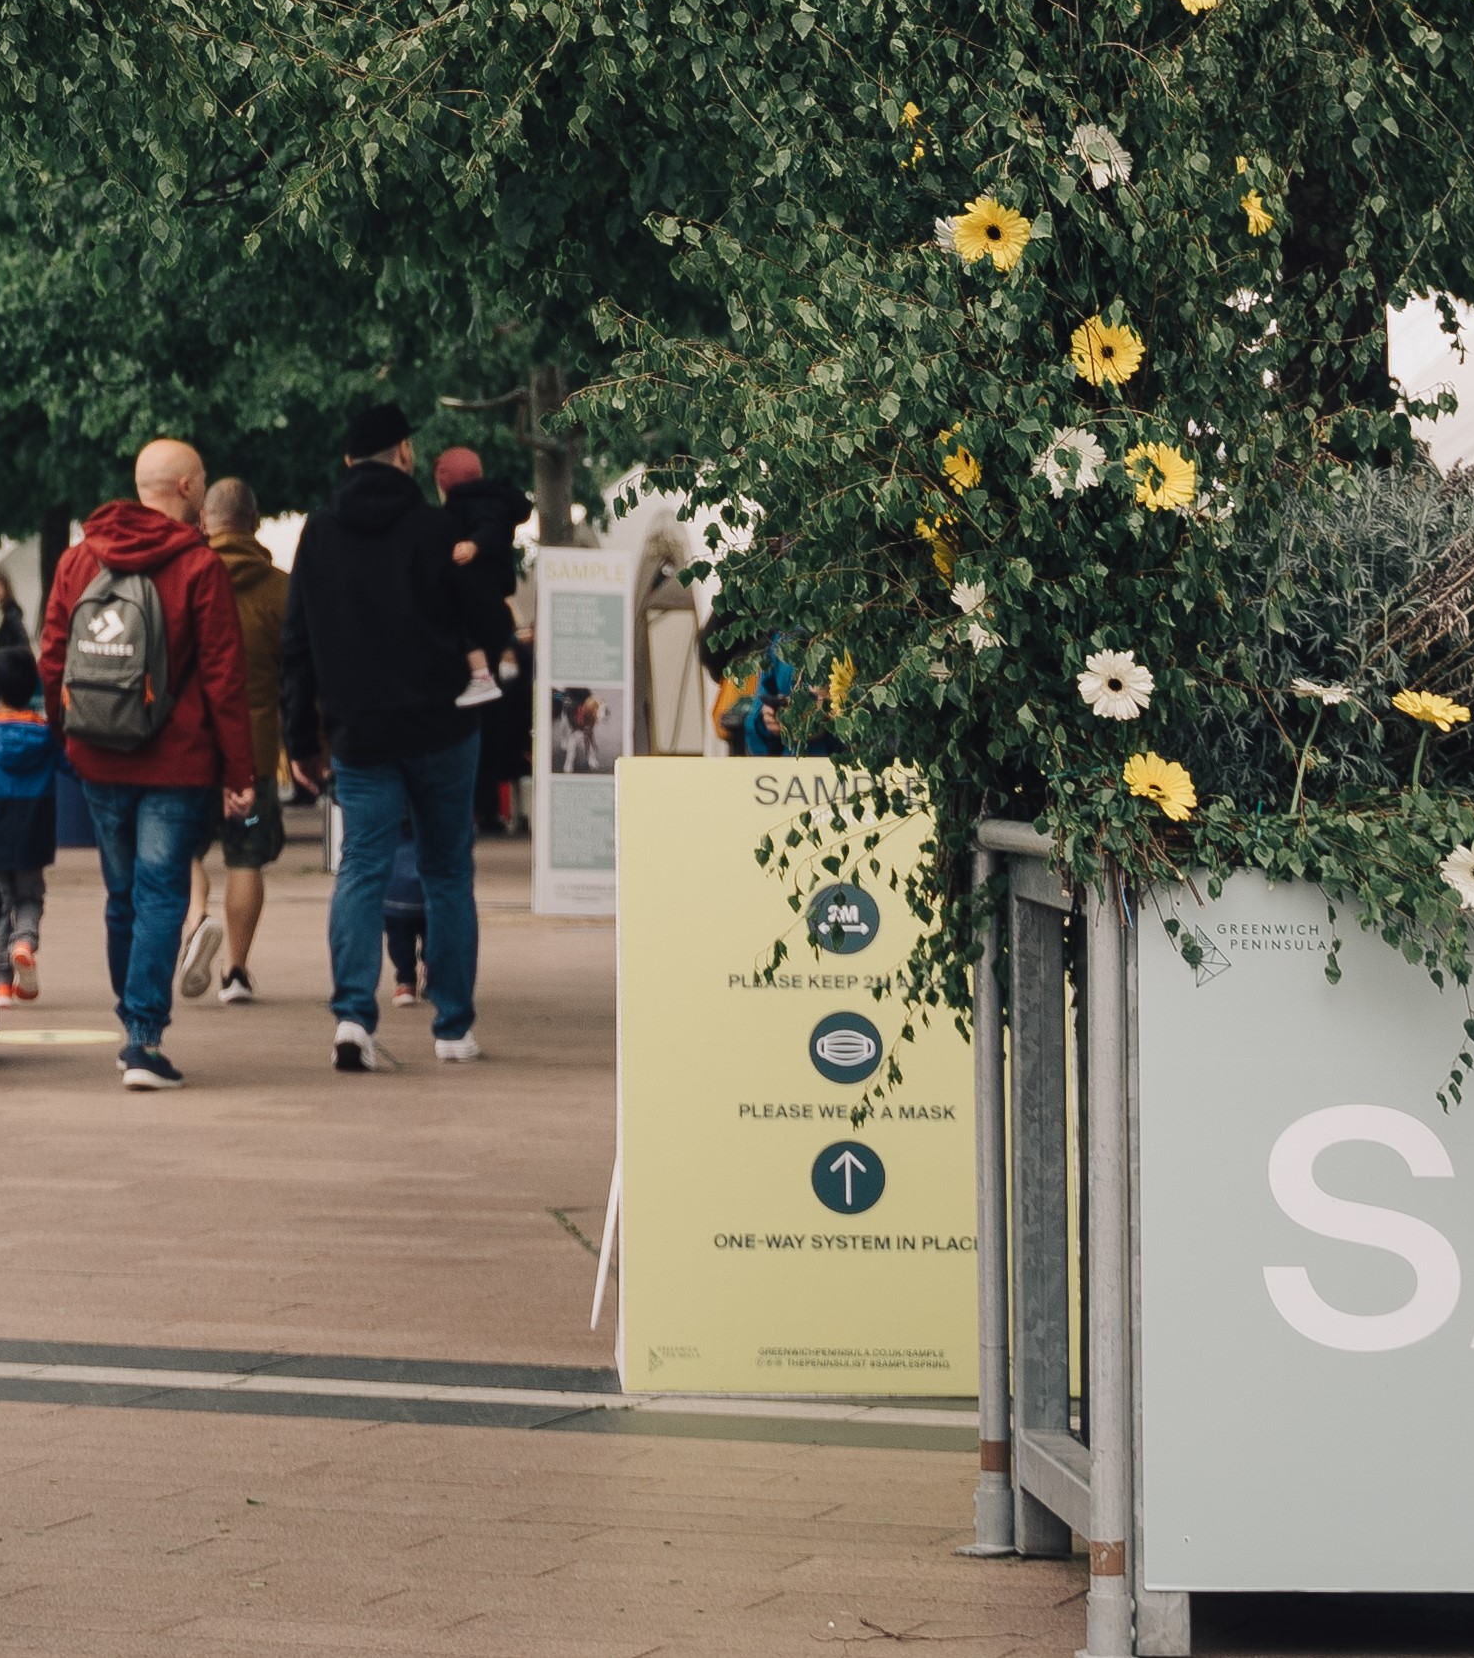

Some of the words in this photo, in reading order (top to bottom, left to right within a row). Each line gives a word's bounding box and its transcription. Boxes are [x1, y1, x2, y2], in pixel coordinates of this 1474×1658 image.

[1216, 923, 1320, 936] GREENWICH
[1229, 938, 1327, 951] PENINSULA
[808, 974, 858, 989] KEEP
[739, 1103, 813, 1119] PLEASE
[880, 1104, 893, 1119] A
[899, 1105, 956, 1120] MASK
[713, 1234, 806, 1250] ONE-WAY
[810, 1234, 890, 1251] SYSTEM
[897, 1235, 915, 1251] IN
[921, 1235, 978, 1252] PLAC
